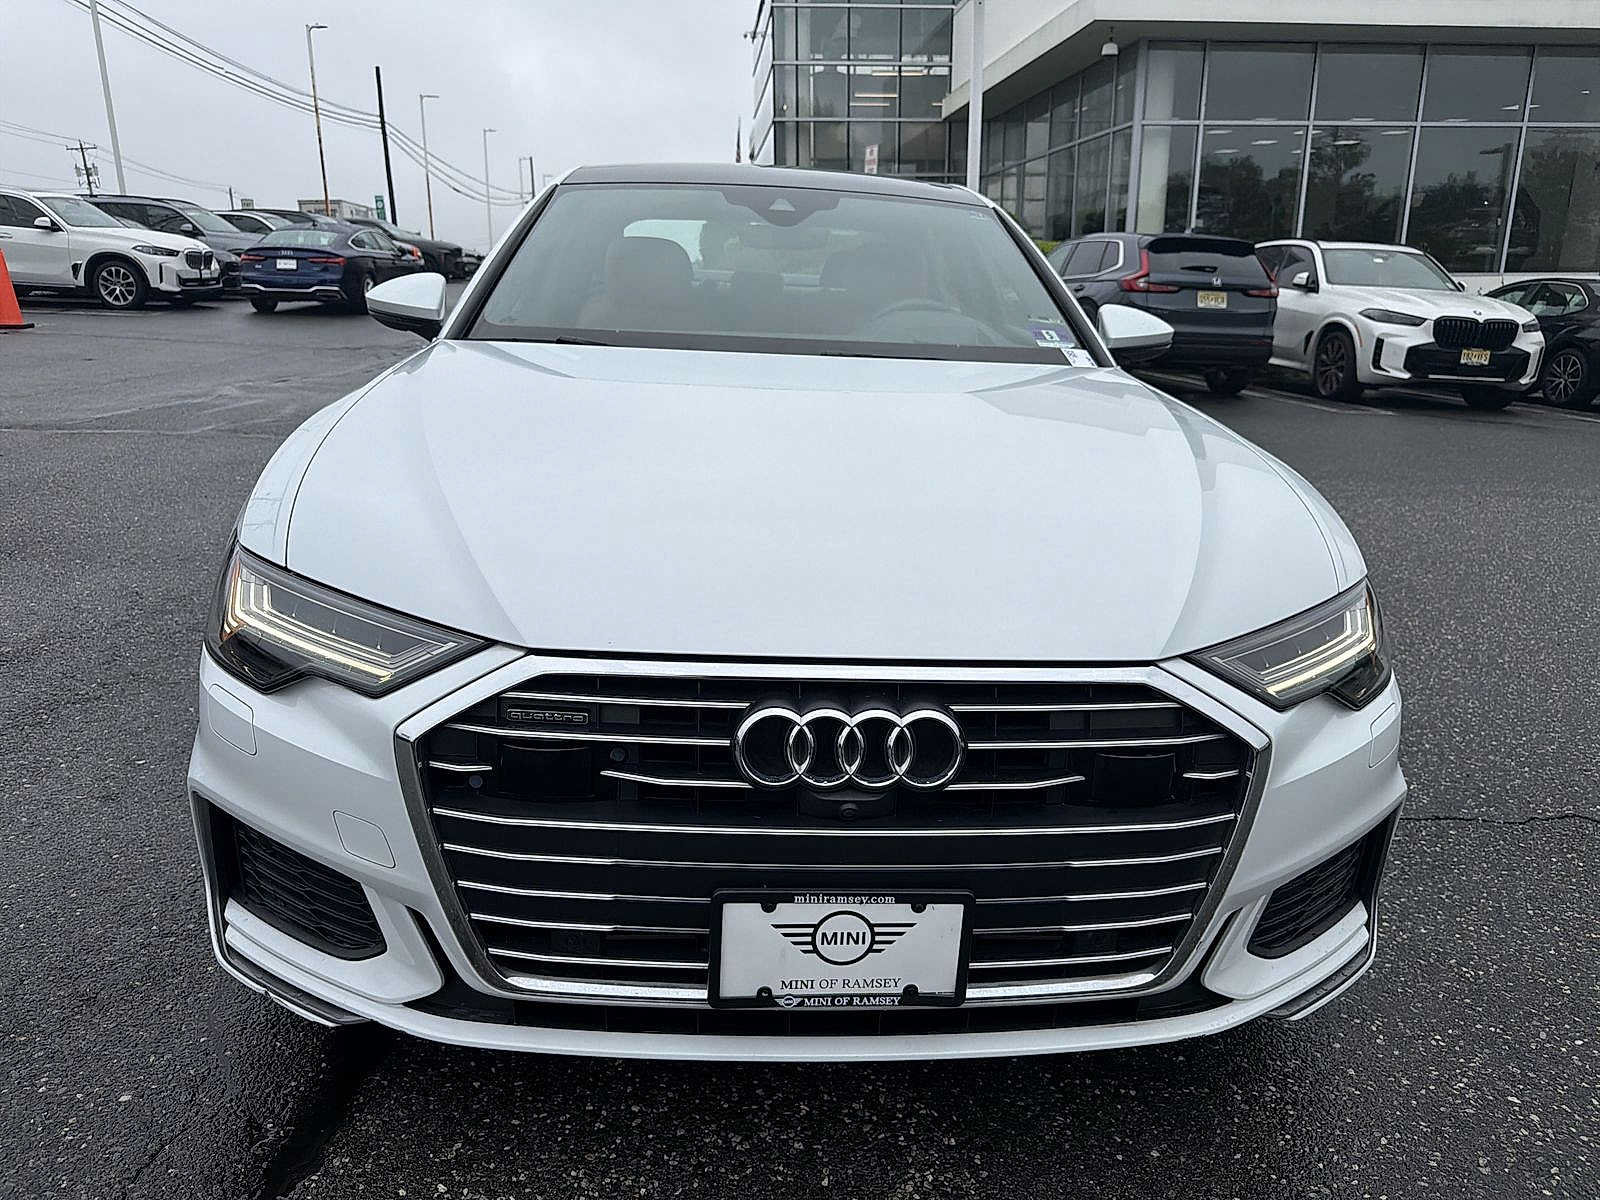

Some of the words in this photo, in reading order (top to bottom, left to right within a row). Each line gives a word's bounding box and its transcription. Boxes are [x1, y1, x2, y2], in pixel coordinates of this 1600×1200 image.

[510, 712, 584, 722] quattro
[794, 894, 895, 905] miniramsey.com
[820, 931, 866, 945] MINI
[780, 979, 815, 989] MINI
[818, 978, 839, 989] OF
[842, 978, 901, 989] RAMSEY
[804, 998, 831, 1006] MINI
[835, 997, 850, 1006] OF
[853, 997, 900, 1006] RAMSEY
